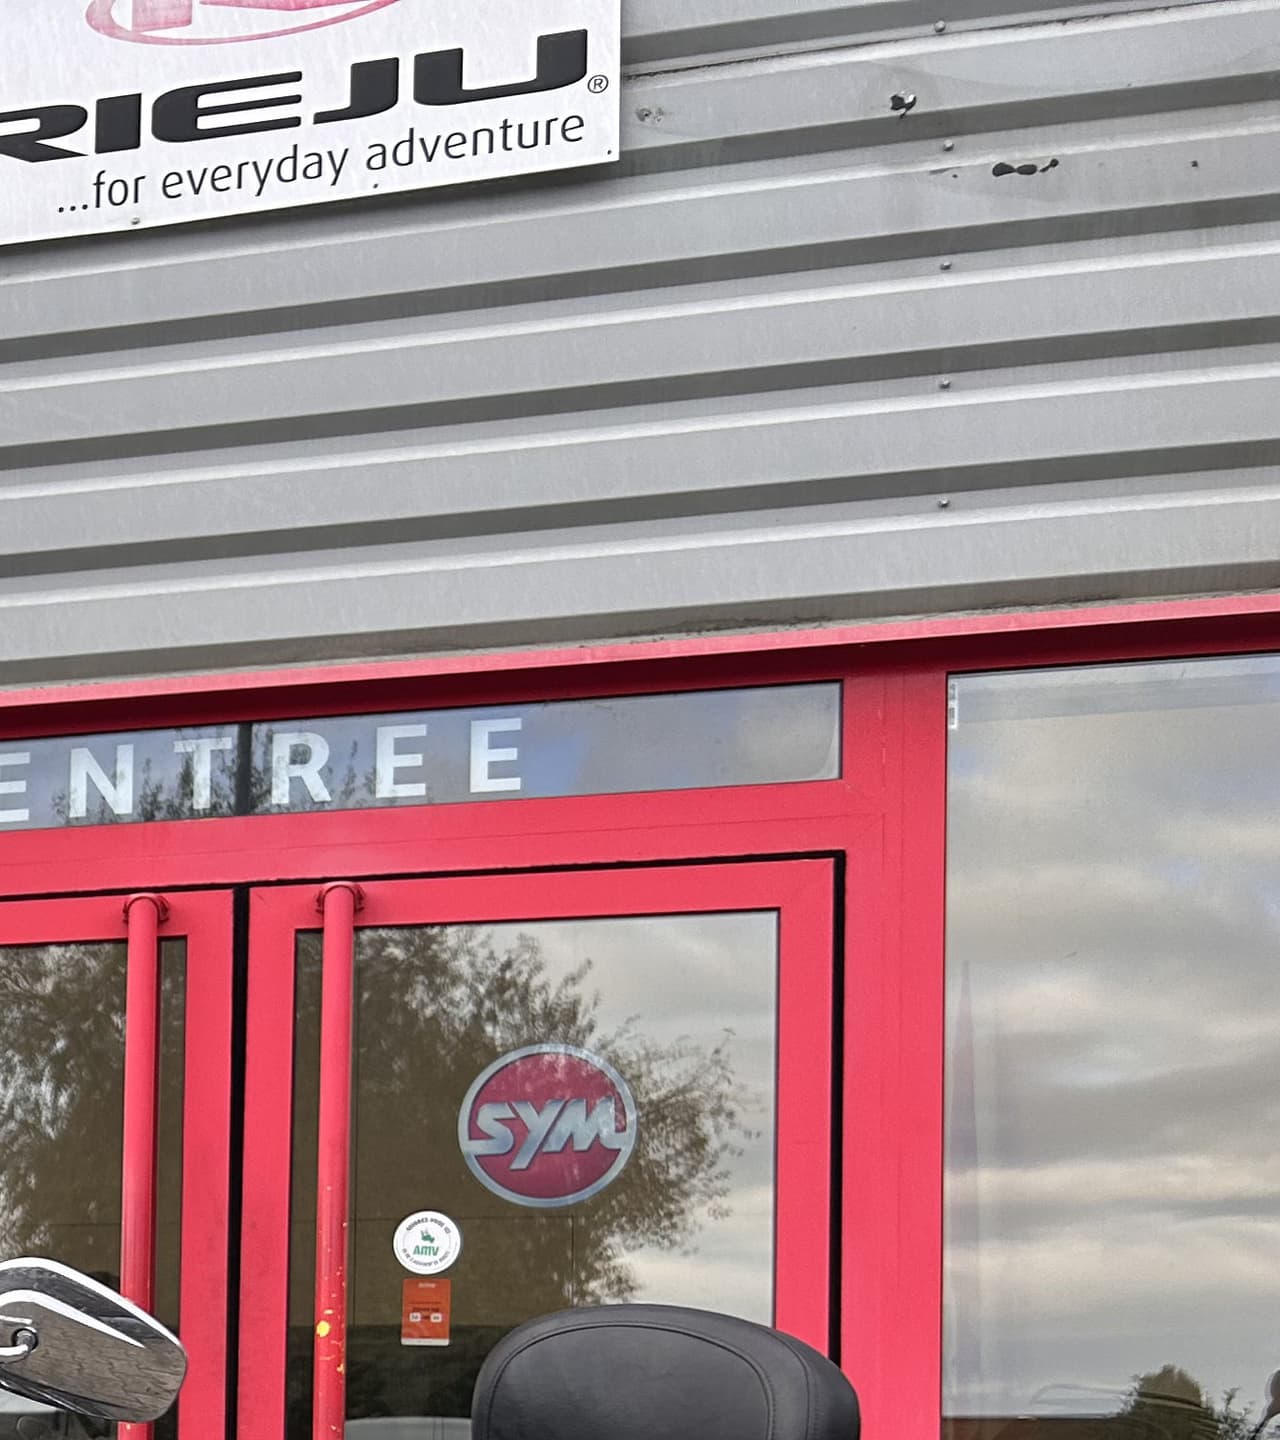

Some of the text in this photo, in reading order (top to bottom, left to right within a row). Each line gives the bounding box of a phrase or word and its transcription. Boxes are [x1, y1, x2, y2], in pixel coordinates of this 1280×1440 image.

[160, 142, 350, 204] everyday
[366, 109, 586, 172] adventure
[467, 1096, 627, 1171] SYM
[413, 1245, 439, 1256] AMV
